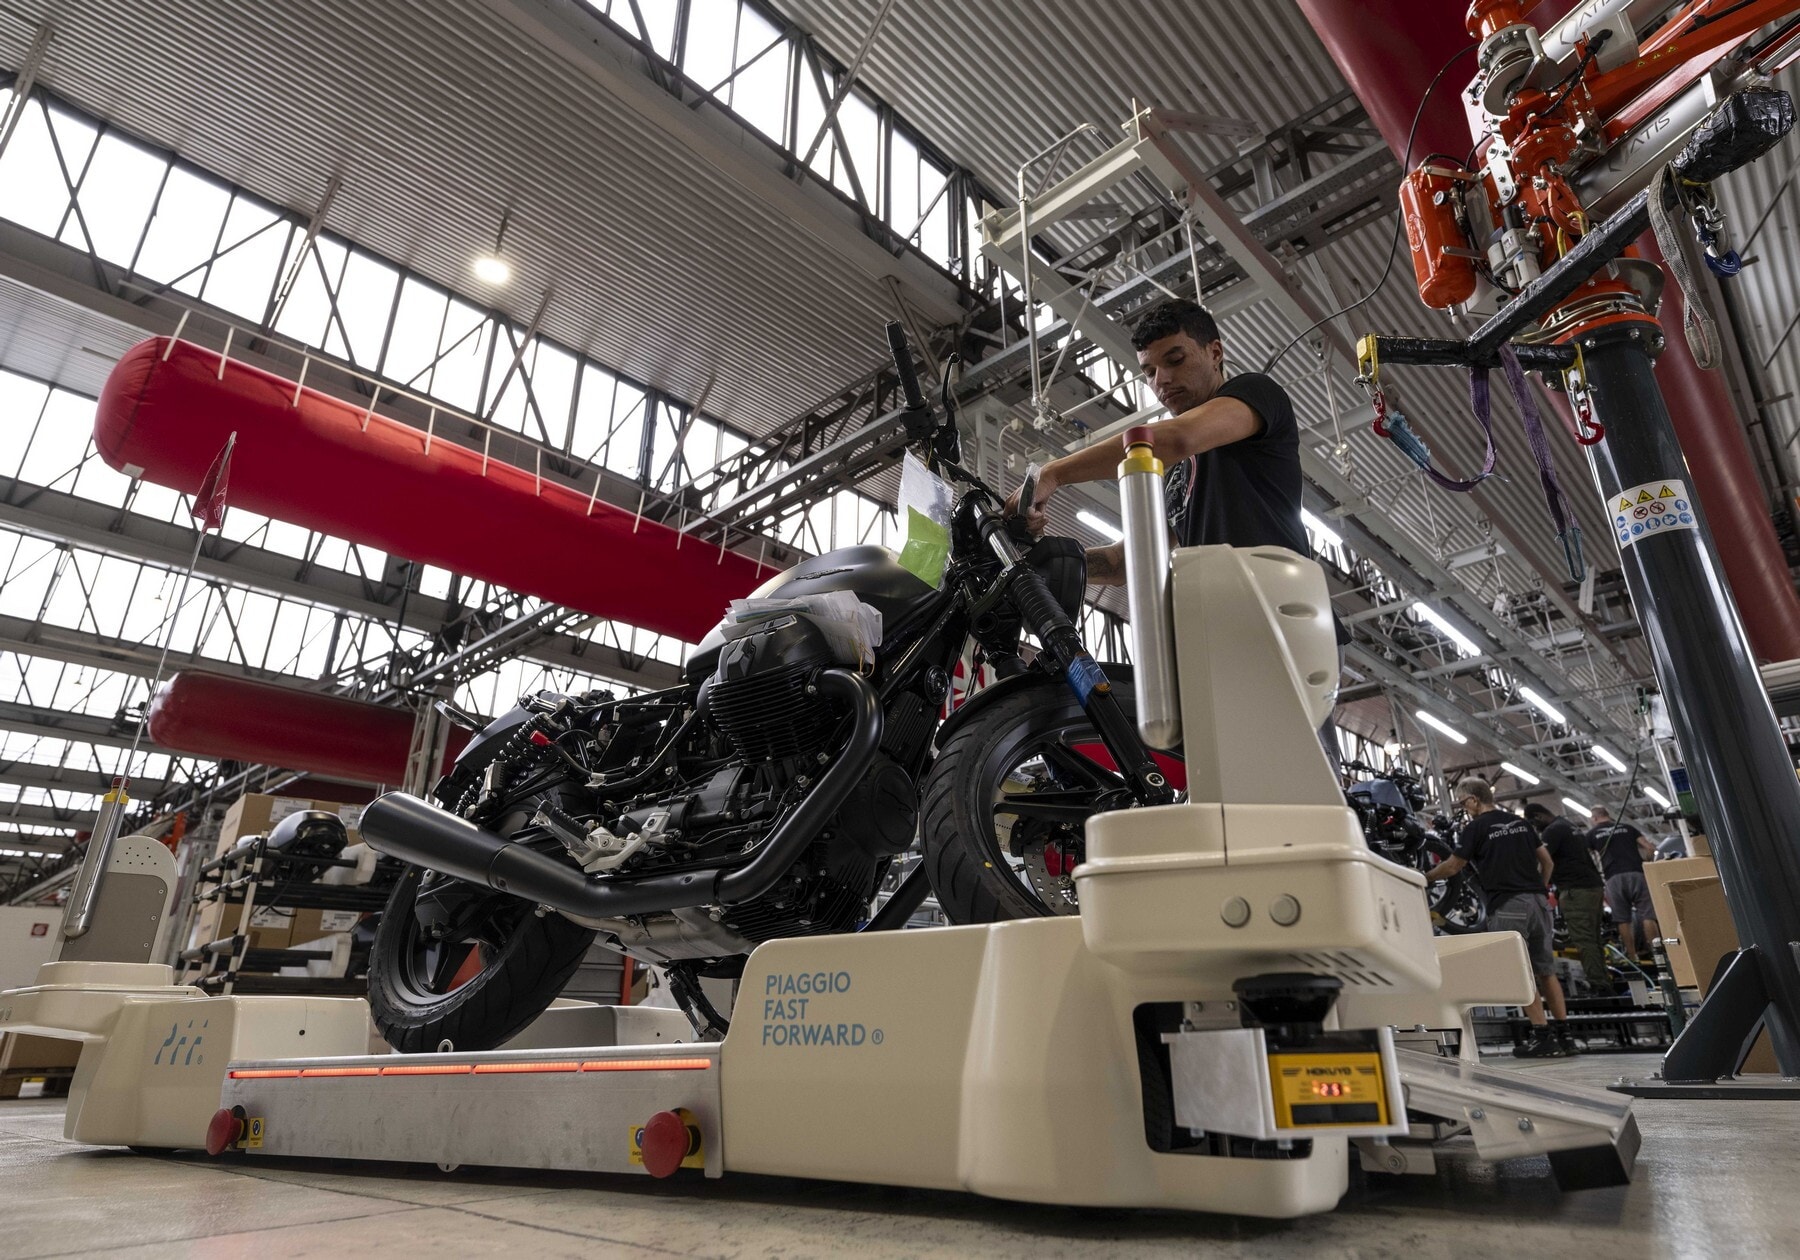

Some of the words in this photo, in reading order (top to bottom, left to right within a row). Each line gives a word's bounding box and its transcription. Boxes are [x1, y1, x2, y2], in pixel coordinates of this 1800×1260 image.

[1489, 829, 1508, 839] MOTO
[766, 971, 851, 995] PIAGGIO
[764, 998, 809, 1020] FAST
[762, 1023, 866, 1046] FORWARD
[1306, 1066, 1352, 1076] HOKUYO
